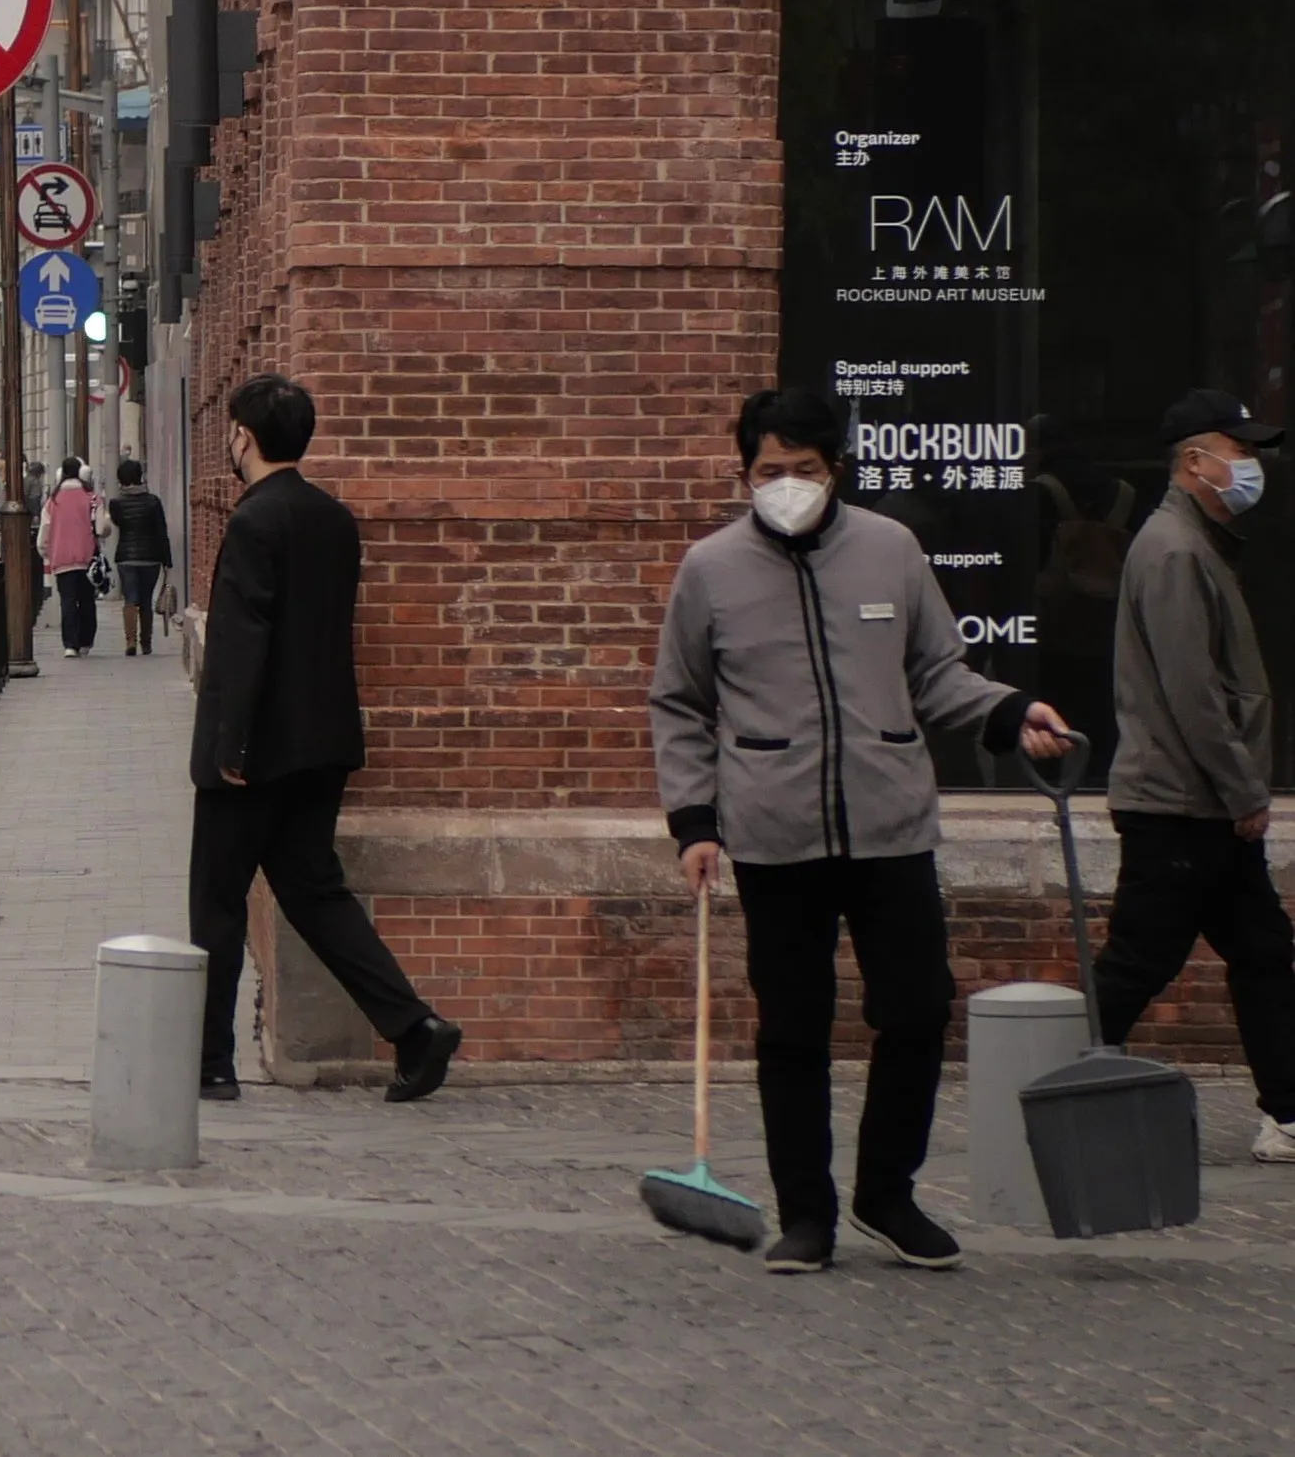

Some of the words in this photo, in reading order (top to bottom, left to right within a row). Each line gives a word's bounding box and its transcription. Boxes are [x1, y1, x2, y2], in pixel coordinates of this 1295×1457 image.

[835, 130, 921, 148] Organizer
[835, 149, 870, 166] 主办
[870, 195, 1012, 251] RAM
[871, 265, 1012, 281] 上海外滩美术馆
[836, 288, 932, 302] ROCKBUND
[936, 288, 968, 301] ART
[972, 288, 1046, 301] MUSEUM
[835, 360, 897, 377] Special
[900, 361, 970, 378] support
[835, 379, 905, 396] 特别支持
[857, 423, 1026, 461] ROCKBUND
[933, 552, 1003, 569] support
